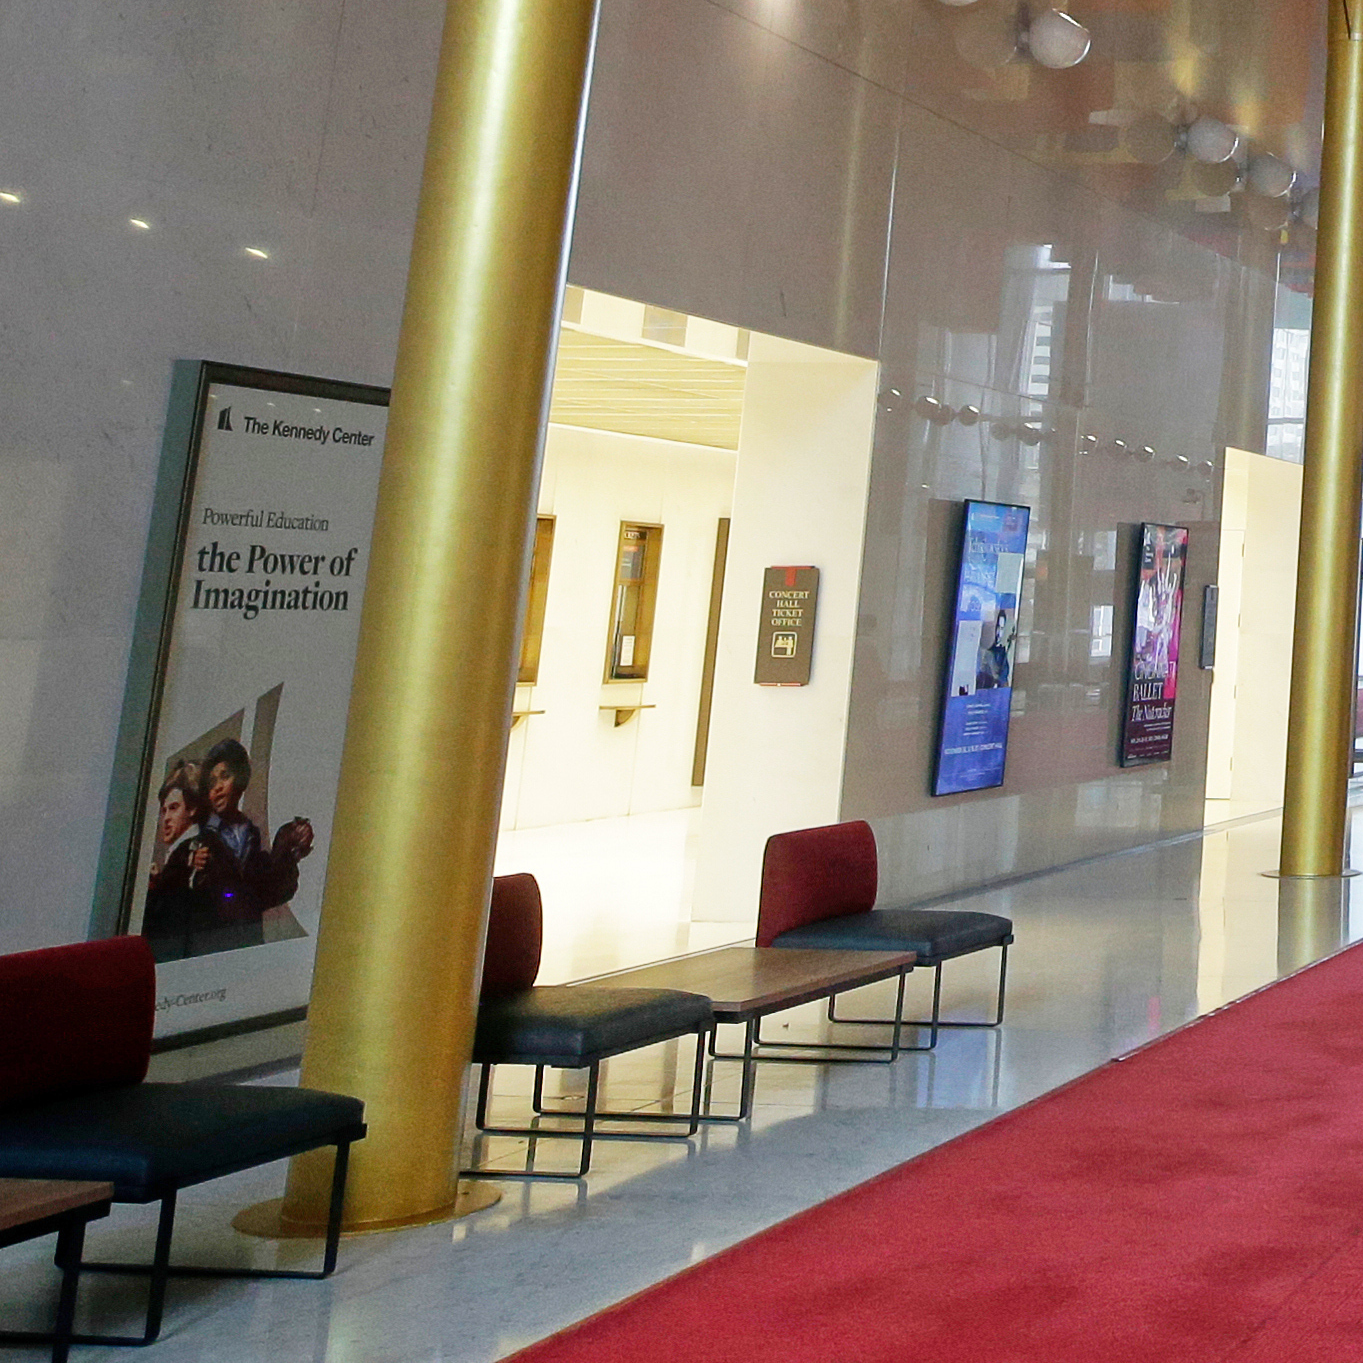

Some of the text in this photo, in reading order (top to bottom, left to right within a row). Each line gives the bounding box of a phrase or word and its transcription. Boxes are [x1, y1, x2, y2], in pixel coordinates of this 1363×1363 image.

[244, 416, 375, 446] The Kennedy Center
[202, 508, 329, 532] Powerful Education
[197, 541, 358, 577] the Power of
[190, 579, 349, 621] Imagination
[769, 590, 810, 599] CONCERT
[776, 599, 800, 608] HALL
[771, 618, 802, 626] OFFICE
[772, 609, 803, 617] TICKET
[155, 988, 227, 1013] edy-Center.org
